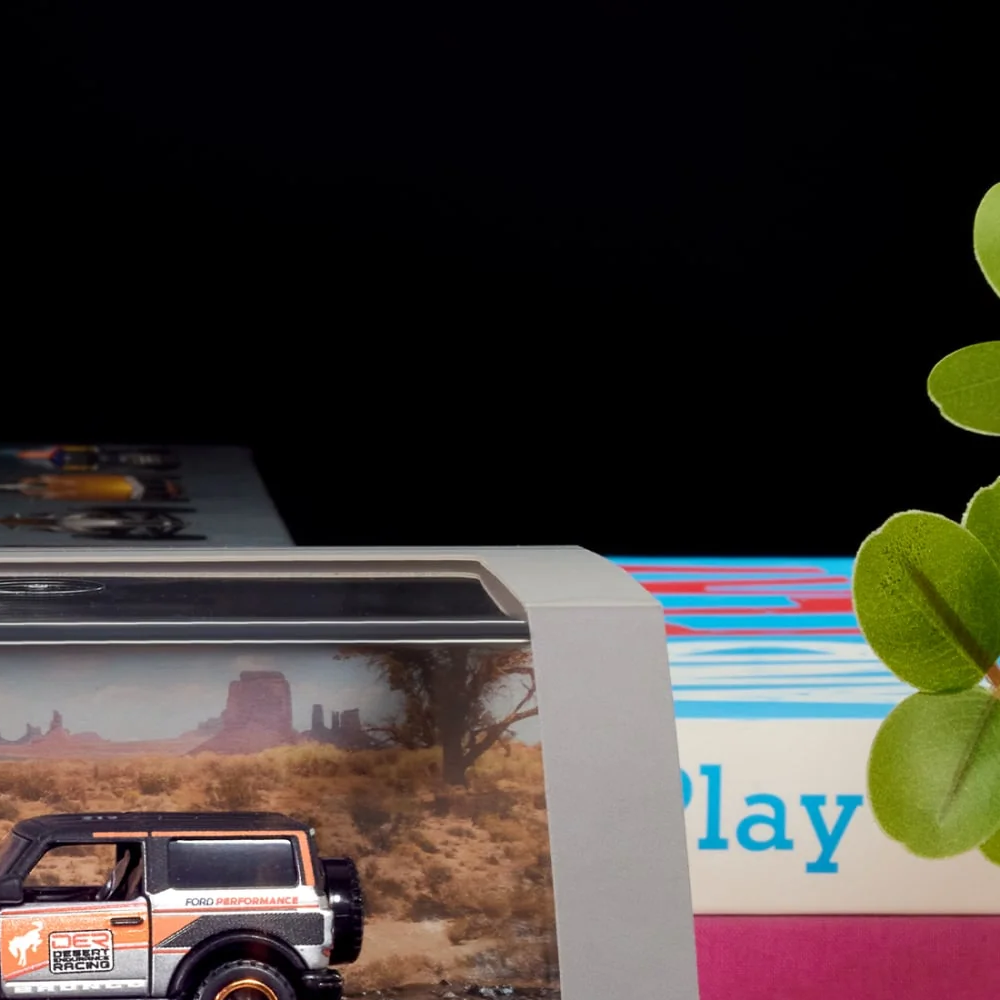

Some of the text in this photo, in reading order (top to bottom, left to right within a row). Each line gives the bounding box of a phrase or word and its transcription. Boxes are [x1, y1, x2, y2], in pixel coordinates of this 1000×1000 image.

[185, 896, 299, 907] FORD PERFORMANCE
[53, 960, 110, 971] RACING
